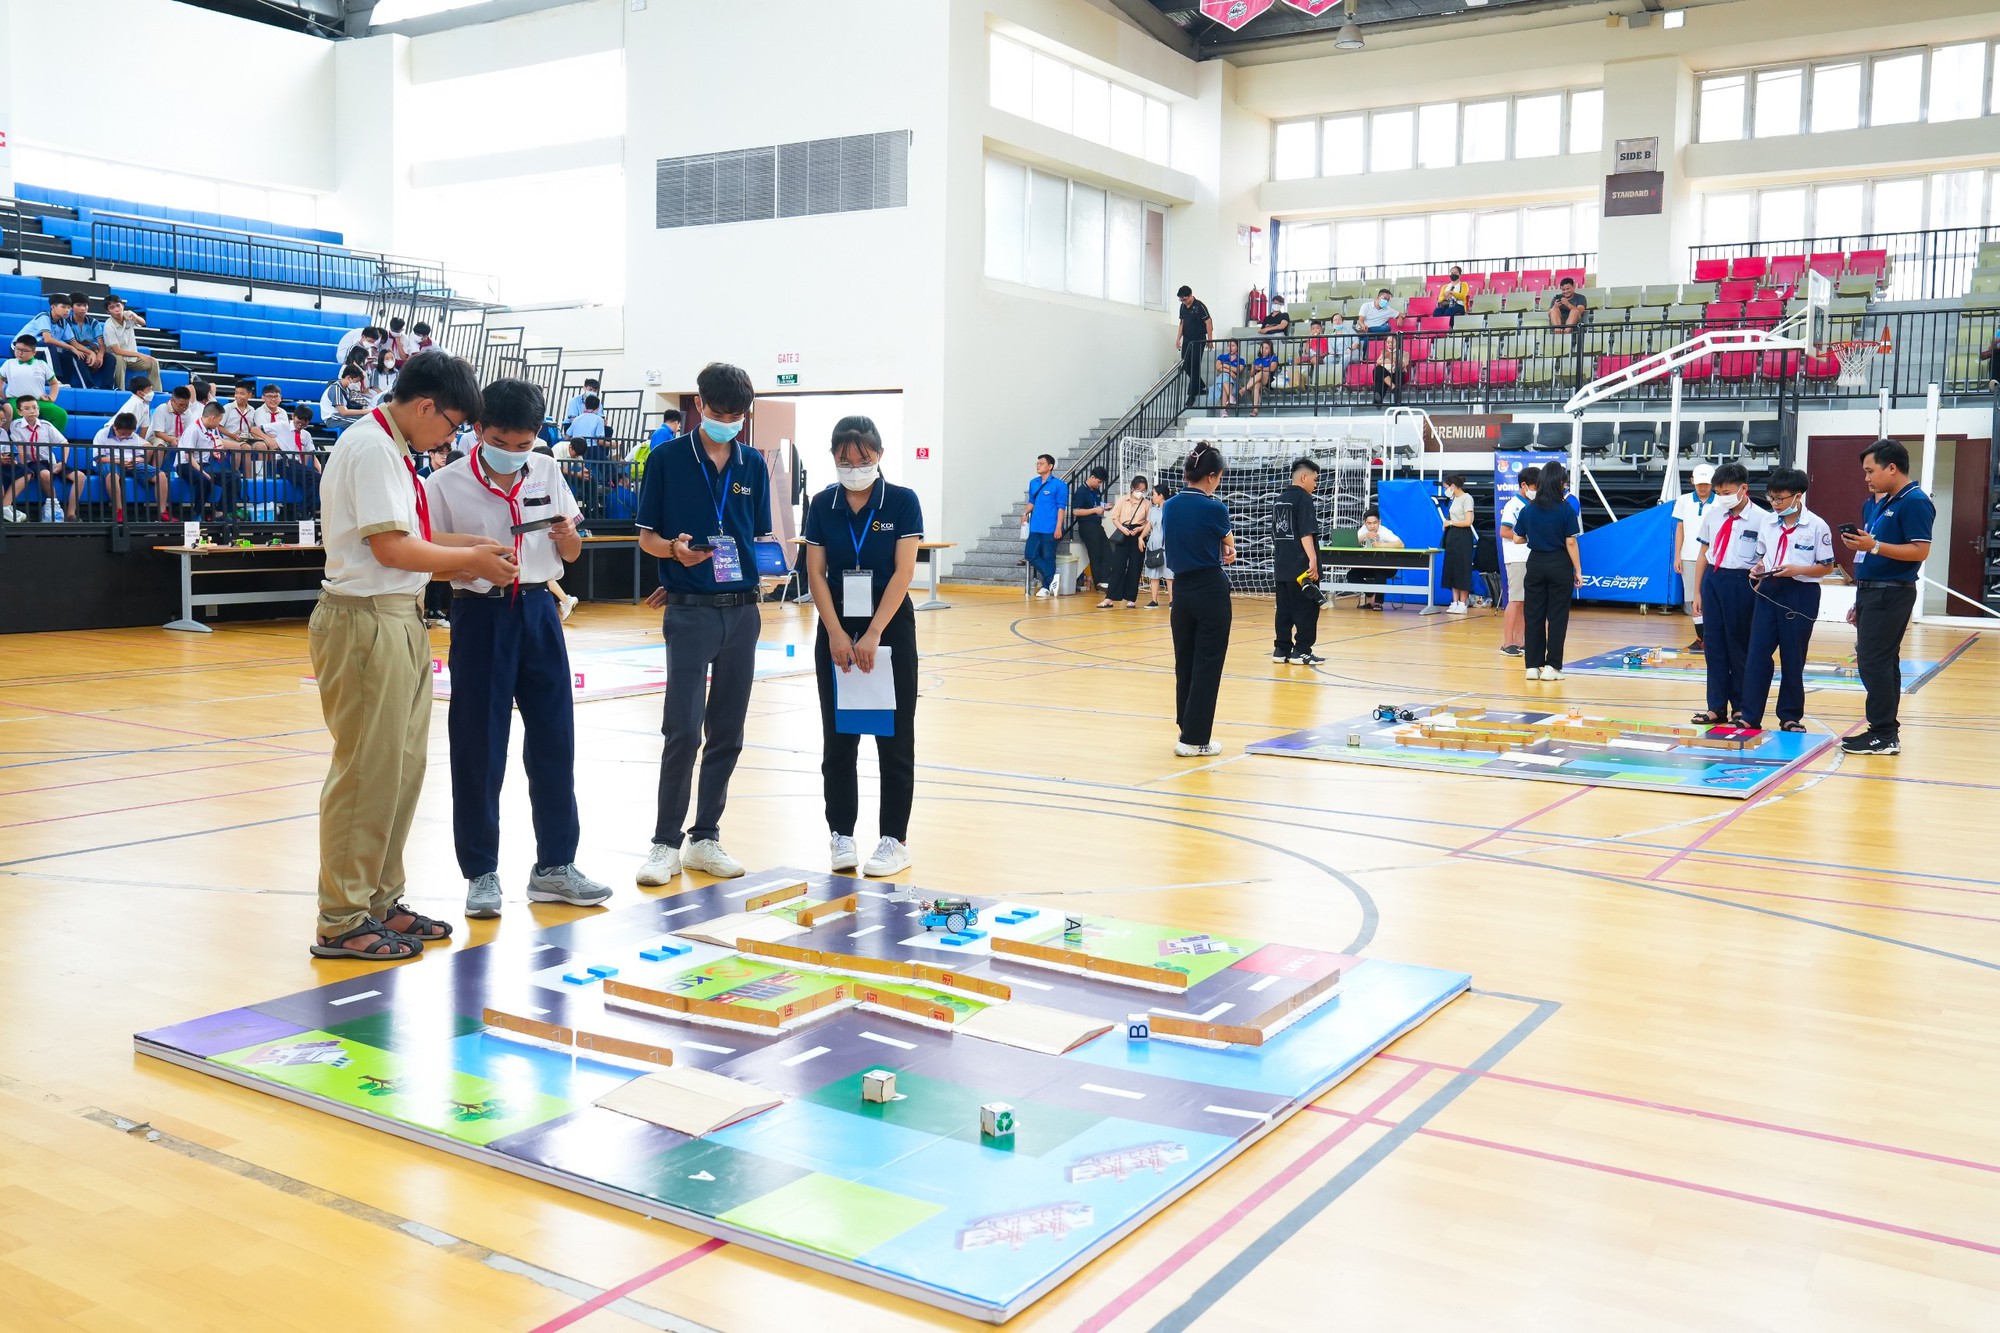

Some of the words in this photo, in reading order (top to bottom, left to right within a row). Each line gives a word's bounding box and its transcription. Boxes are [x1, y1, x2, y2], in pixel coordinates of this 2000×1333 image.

[1620, 152, 1642, 161] SIDE
[1645, 151, 1651, 159] B
[1612, 190, 1649, 199] STANDARD
[778, 353, 793, 363] GATE
[795, 353, 799, 363] 3
[1431, 425, 1486, 439] PREMIUM
[1497, 482, 1519, 491] VÒNG
[1581, 575, 1604, 587] EX
[1601, 580, 1646, 589] SPORT
[1065, 917, 1081, 932] A
[664, 975, 714, 992] KD
[1129, 1024, 1148, 1039] B
